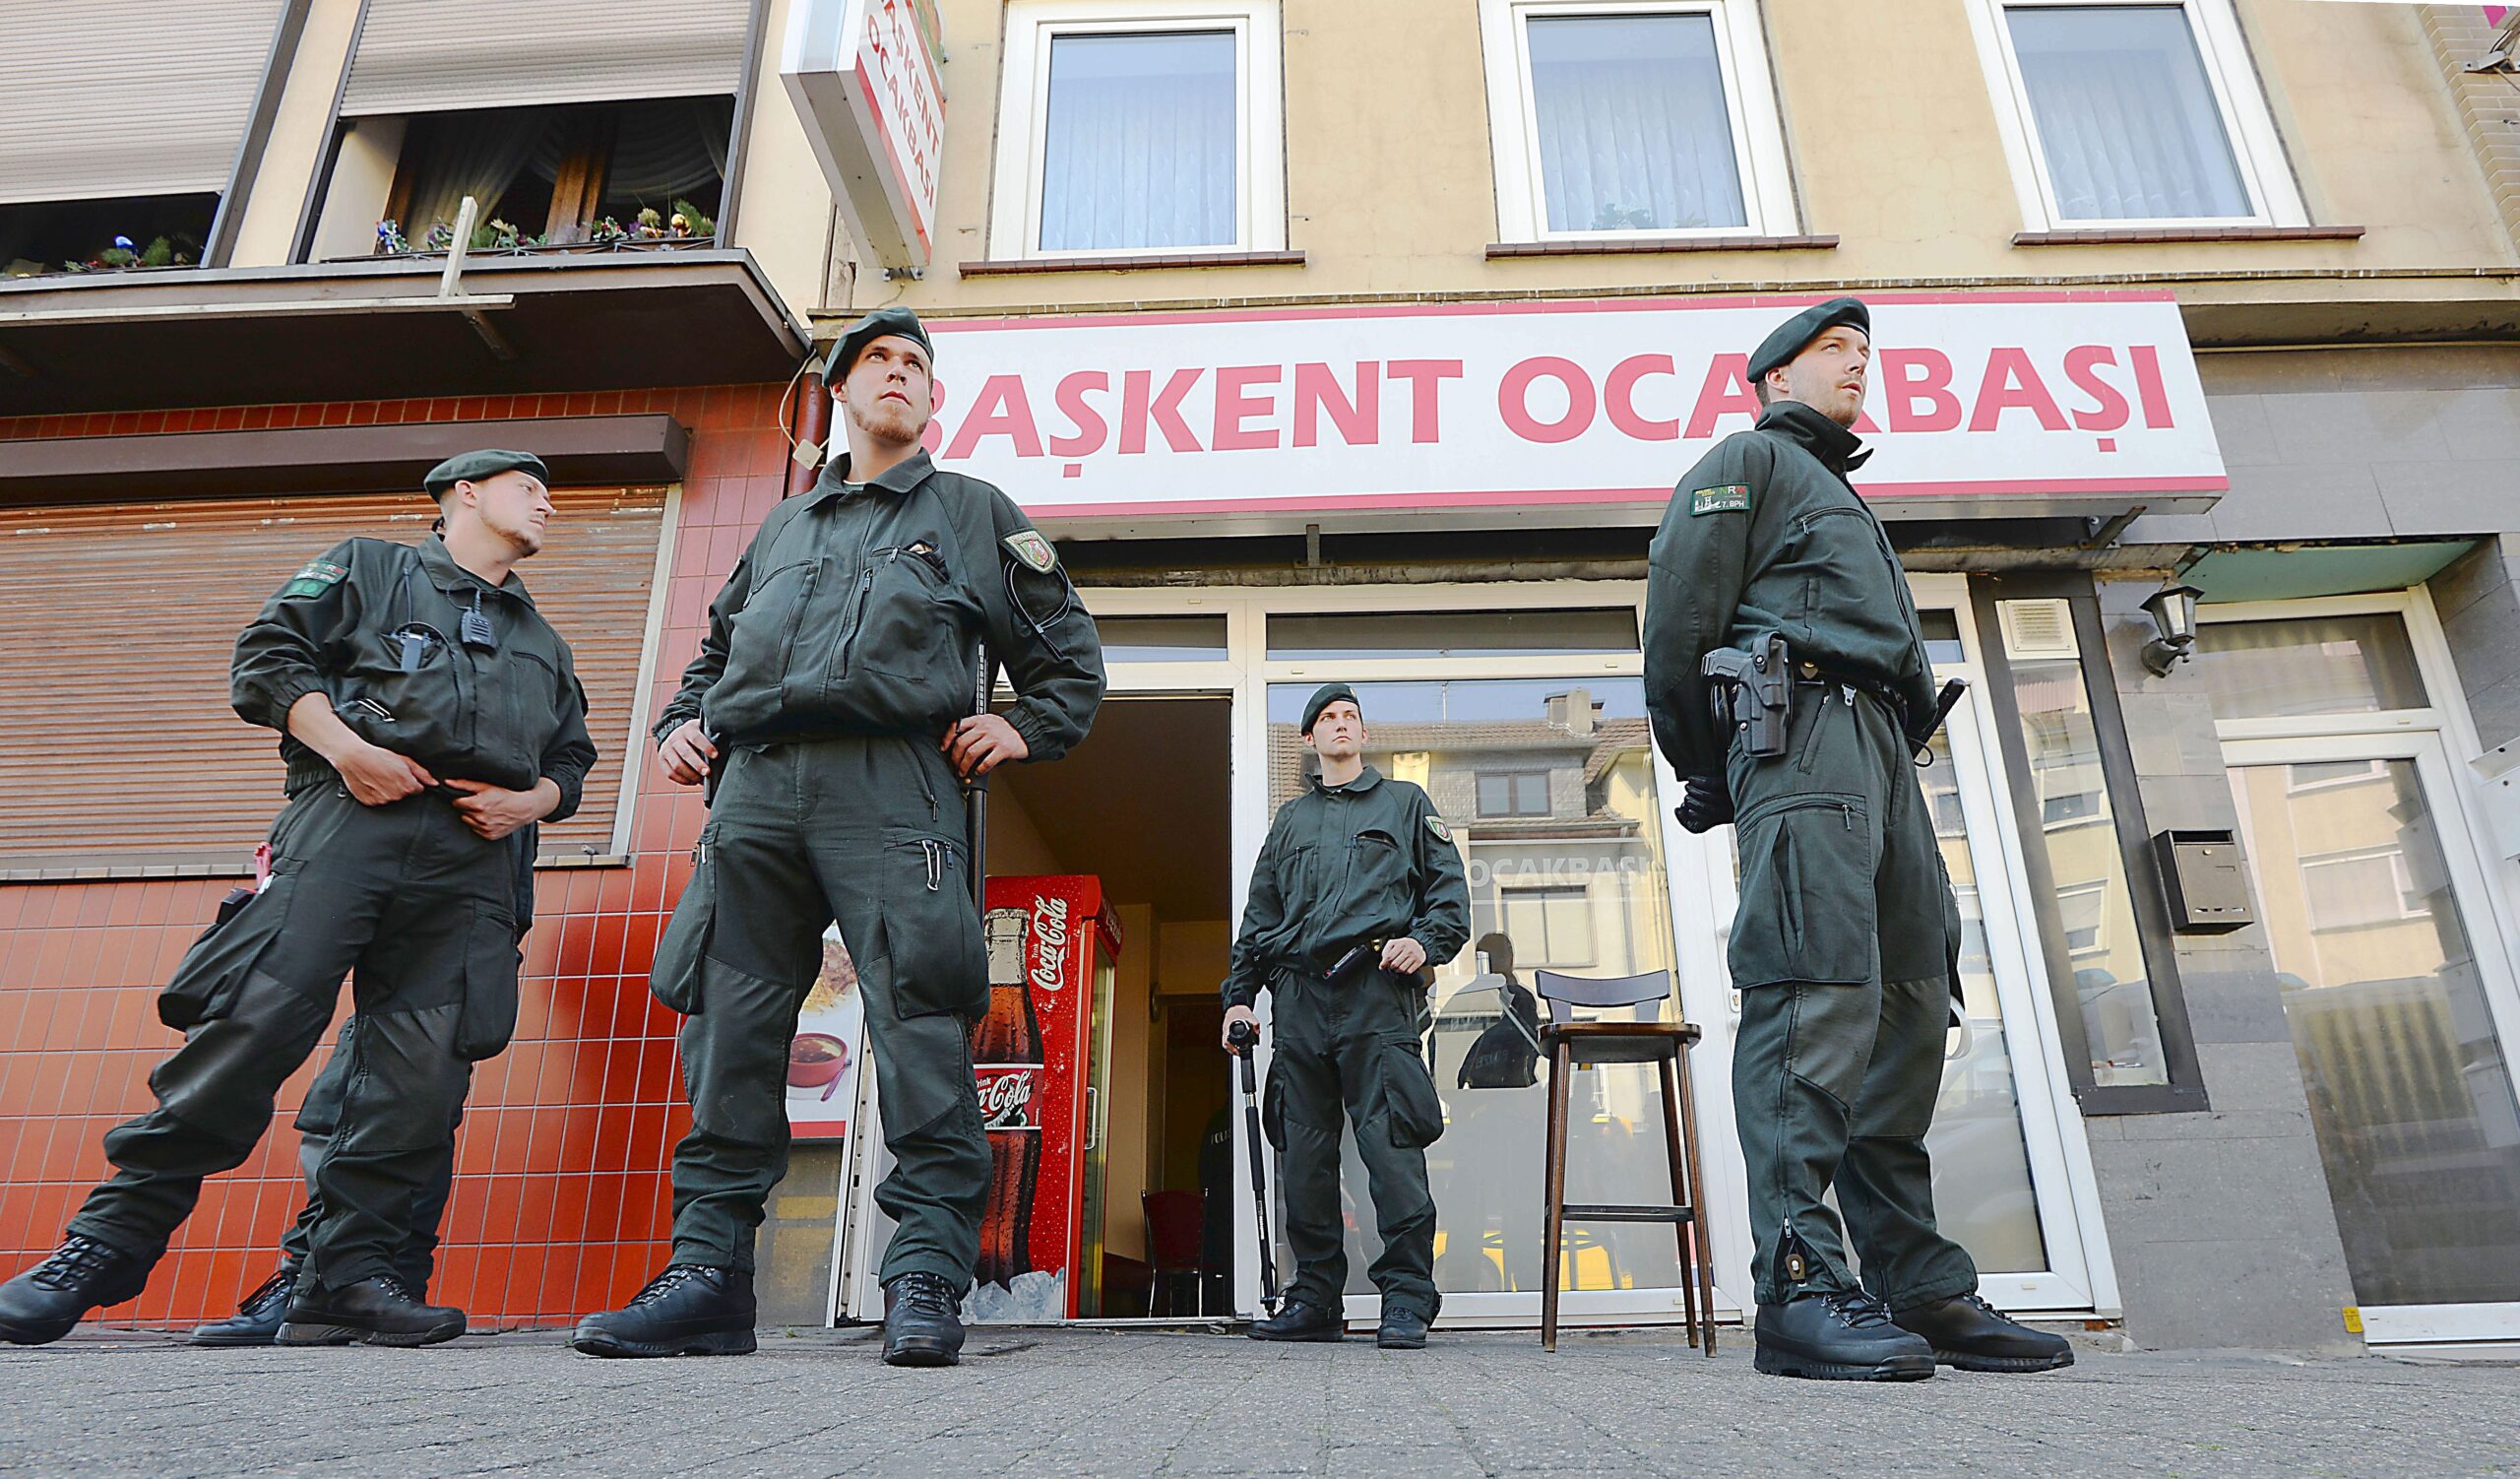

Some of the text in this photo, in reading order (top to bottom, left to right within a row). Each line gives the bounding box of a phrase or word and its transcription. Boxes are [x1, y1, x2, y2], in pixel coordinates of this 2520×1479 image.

[882, 0, 940, 156] AŞKENT
[1497, 345, 2175, 453] OCABAŞI
[1031, 894, 1067, 992] Coca-Cola
[976, 1077, 991, 1088] rink
